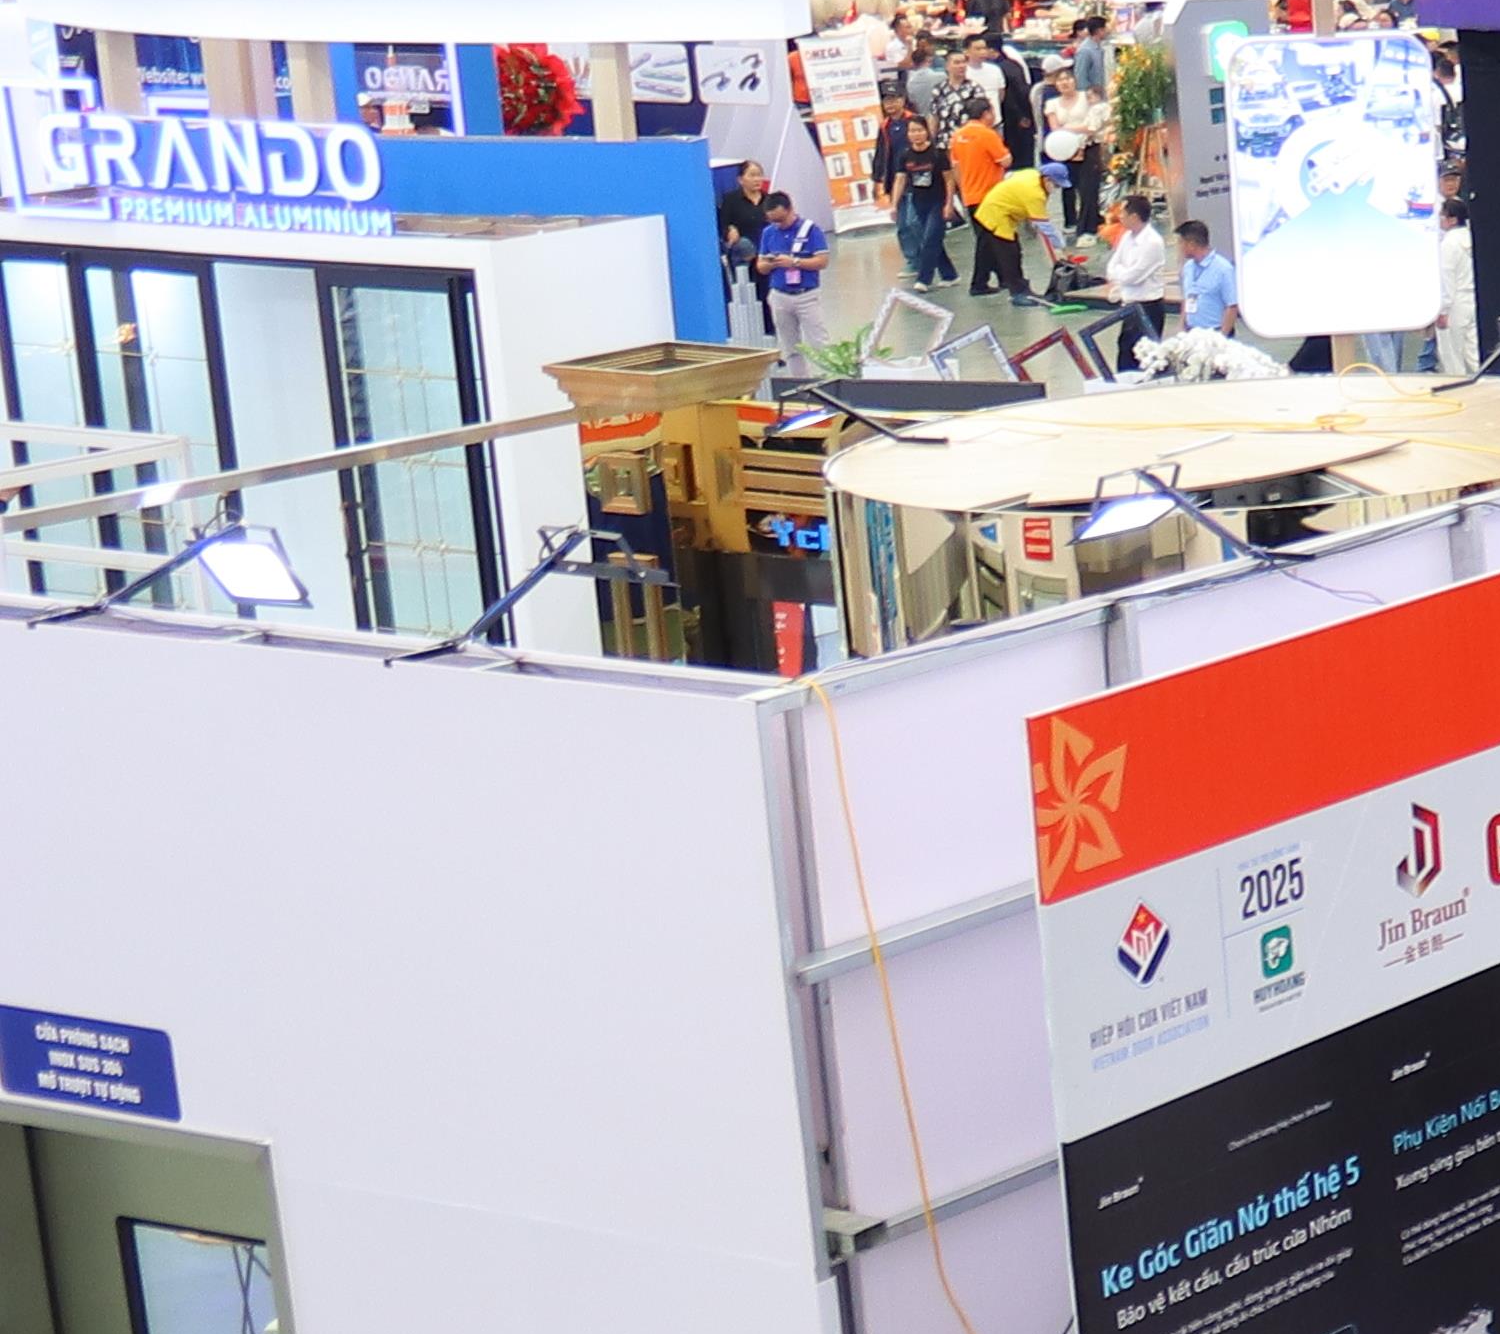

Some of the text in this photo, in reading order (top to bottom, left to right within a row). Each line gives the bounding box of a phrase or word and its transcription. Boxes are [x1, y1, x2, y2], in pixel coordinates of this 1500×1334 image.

[38, 112, 382, 204] GRANDO
[119, 196, 393, 237] PREMIUM ALUMINIUM
[1238, 857, 1305, 921] 2025
[1377, 893, 1469, 951] Jin Braun
[33, 1020, 131, 1057] CỬA PHÒNG SẠCH
[1100, 1155, 1360, 1299] Ke Góc Giãn Nở thế hệ 5
